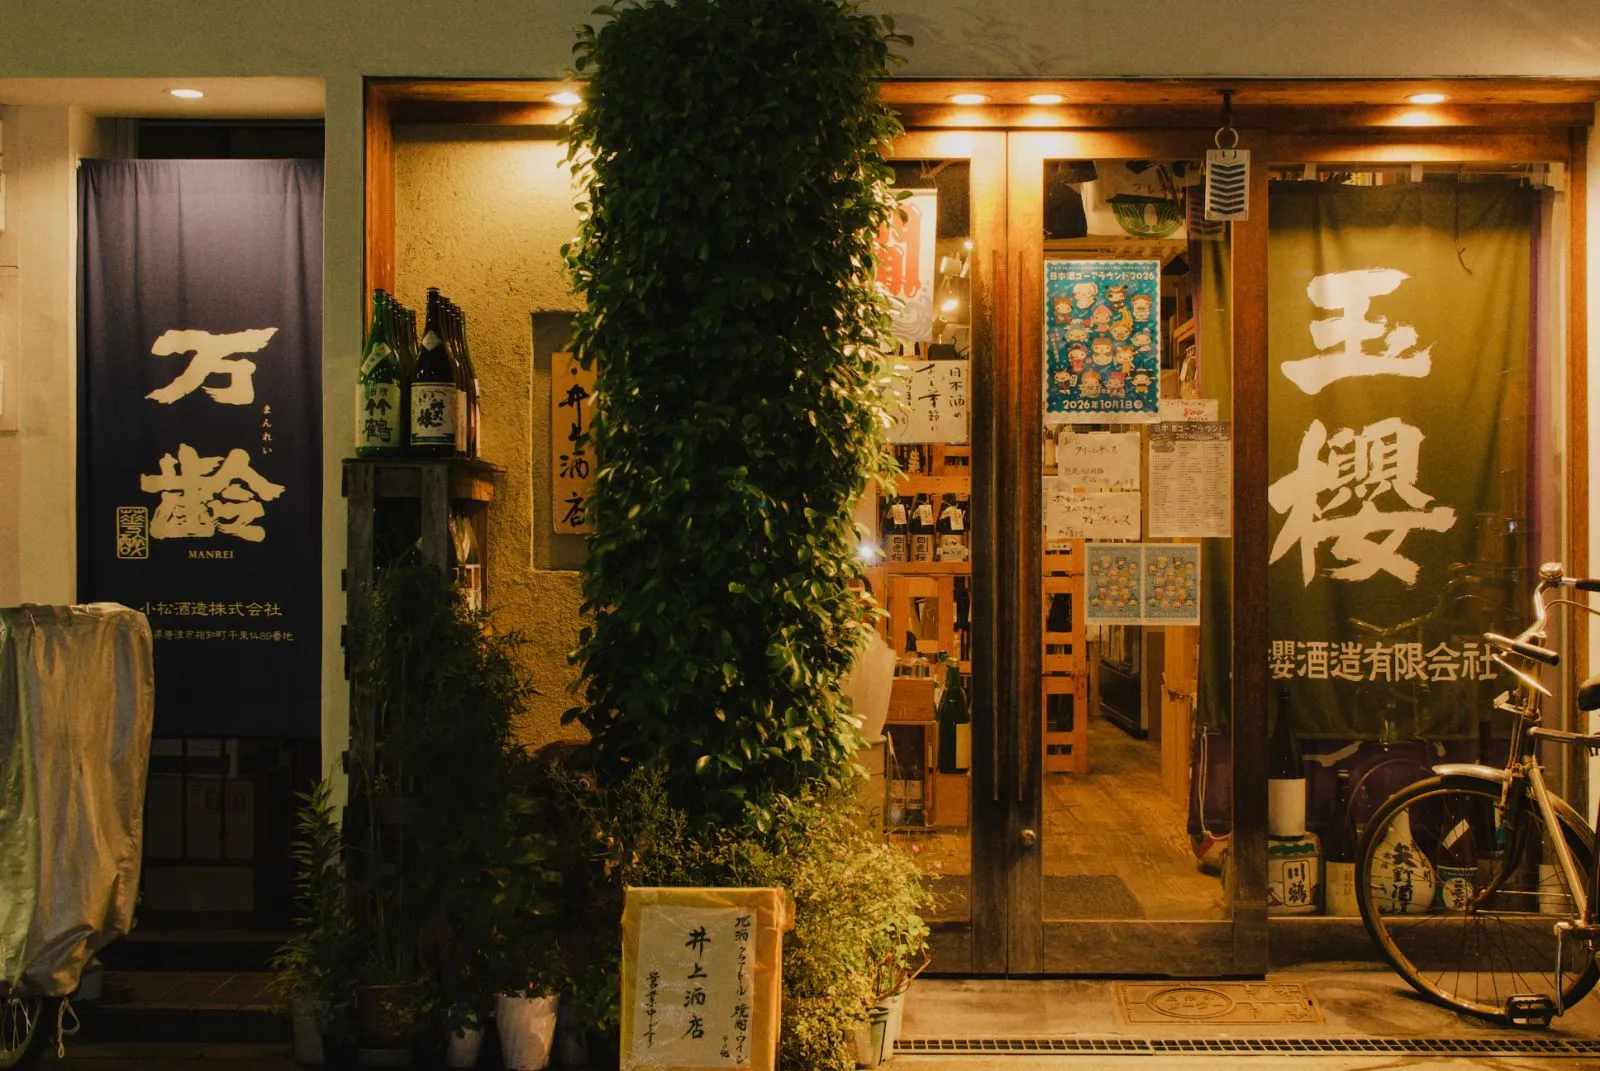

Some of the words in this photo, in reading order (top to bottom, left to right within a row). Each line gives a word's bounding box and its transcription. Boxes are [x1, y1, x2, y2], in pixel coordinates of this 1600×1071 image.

[949, 366, 965, 418] 日本酒の
[262, 404, 273, 455] まんれい
[361, 397, 393, 443] 竹鶴
[1268, 267, 1457, 588] 玉櫻
[188, 549, 234, 559] MANREI
[139, 601, 283, 617] 小松酒造株式会社
[1287, 861, 1307, 904] 川鶴
[680, 925, 712, 1041] 井上酒店
